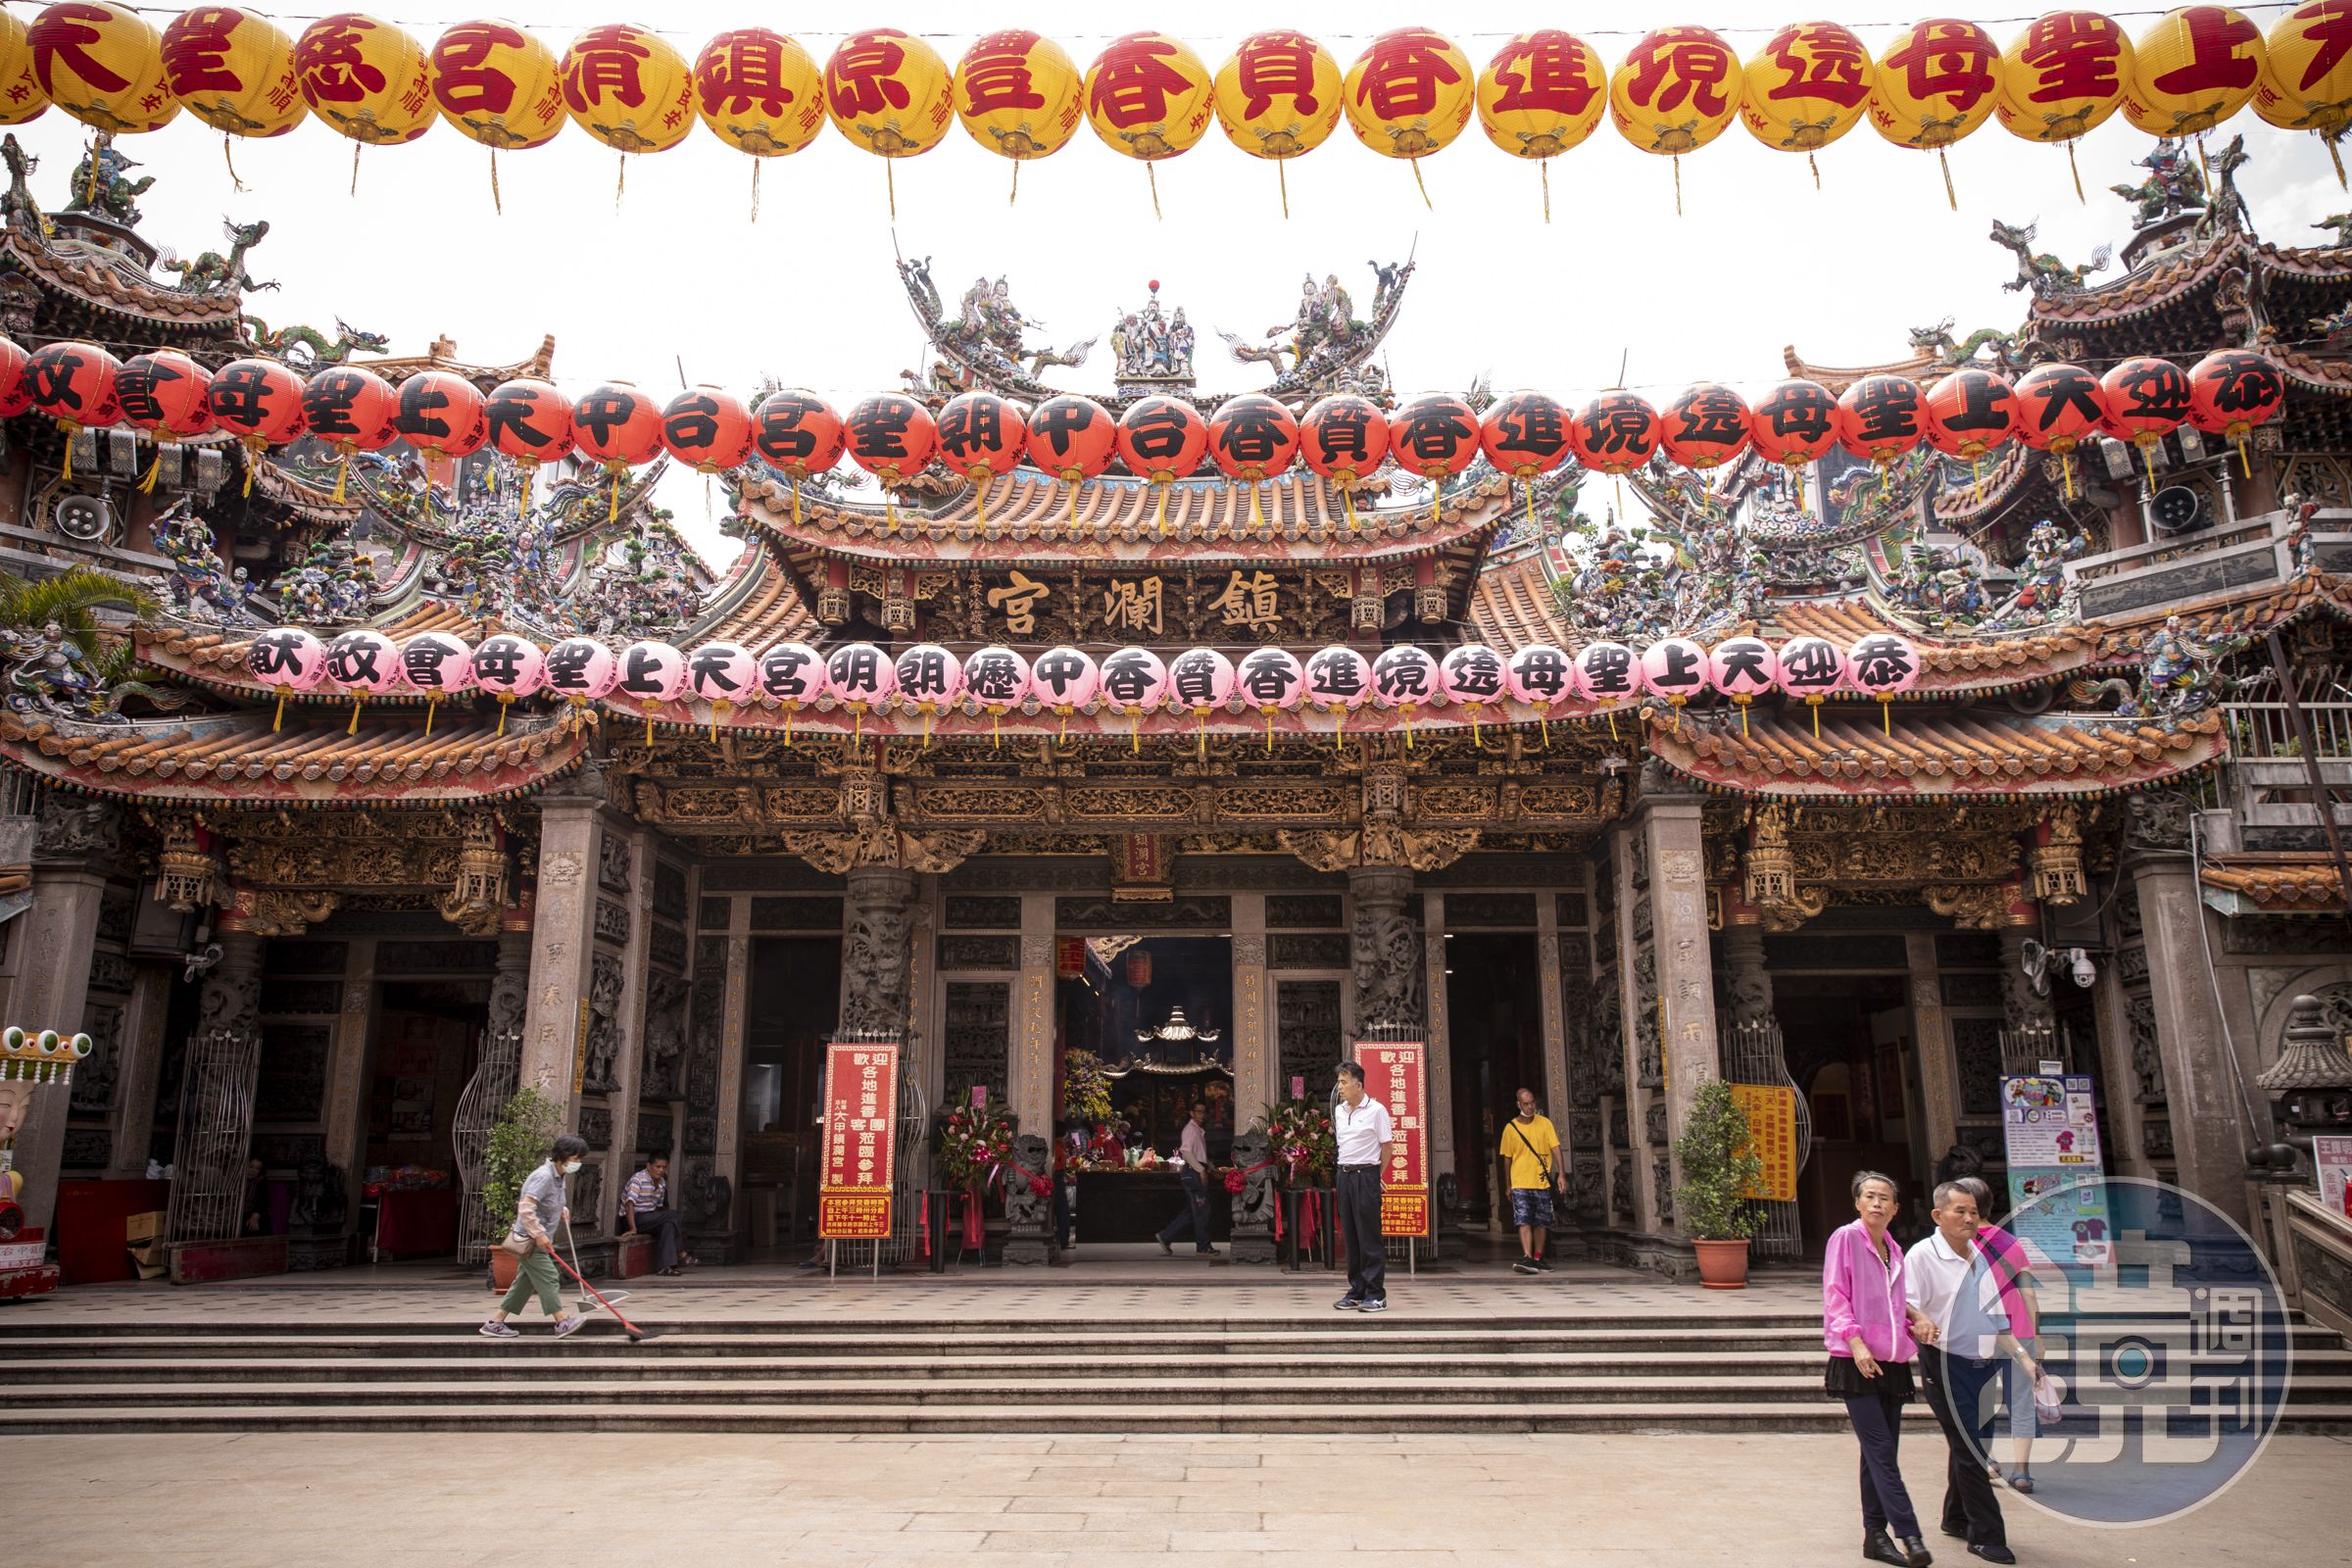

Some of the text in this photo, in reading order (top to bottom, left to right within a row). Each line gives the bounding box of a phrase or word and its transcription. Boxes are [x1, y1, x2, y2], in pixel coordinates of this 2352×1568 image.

[560, 24, 650, 113] 清
[827, 28, 910, 119] 原
[1090, 31, 1196, 128] 香
[1352, 26, 1461, 120] 香
[1490, 29, 1600, 115] 進
[1626, 24, 1728, 118] 境
[1886, 19, 1998, 112] 母
[2021, 11, 2121, 102] 聖
[2153, 7, 2258, 94] 上
[208, 366, 273, 426] 母
[394, 375, 451, 438] 上
[484, 387, 553, 447] 天
[573, 387, 635, 447] 中
[664, 392, 719, 449] 台
[852, 396, 914, 457] 聖
[939, 396, 1003, 457] 朝
[1033, 397, 1095, 456] 中
[1127, 400, 1188, 459] 台
[1214, 396, 1289, 462] 香
[1393, 396, 1472, 459] 香
[1494, 394, 1566, 456] 進
[1583, 393, 1654, 454] 境
[1752, 387, 1836, 443] 母
[1852, 375, 1918, 440] 聖
[1942, 369, 2011, 429] 上
[2033, 366, 2104, 430] 天
[2120, 360, 2193, 417] 迎
[326, 636, 381, 683] 敬
[403, 637, 459, 686] 會
[472, 639, 524, 684] 母
[546, 640, 595, 688] 聖
[619, 647, 663, 693] 上
[690, 648, 742, 694] 天
[762, 648, 811, 697] 宮
[830, 650, 879, 692] 明
[896, 651, 947, 697] 朝
[1036, 651, 1085, 697] 中
[1104, 652, 1157, 701] 香
[1244, 652, 1298, 700] 香
[1310, 651, 1365, 697] 進
[1376, 650, 1429, 697] 境
[1513, 650, 1567, 694] 母
[1585, 647, 1632, 693] 聖
[1652, 645, 1699, 687] 上
[1720, 643, 1769, 687] 天
[1783, 641, 1842, 686] 迎
[1857, 638, 1913, 685] 恭
[854, 1053, 888, 1065] 歡迎
[1380, 1051, 1414, 1063] 歡迎
